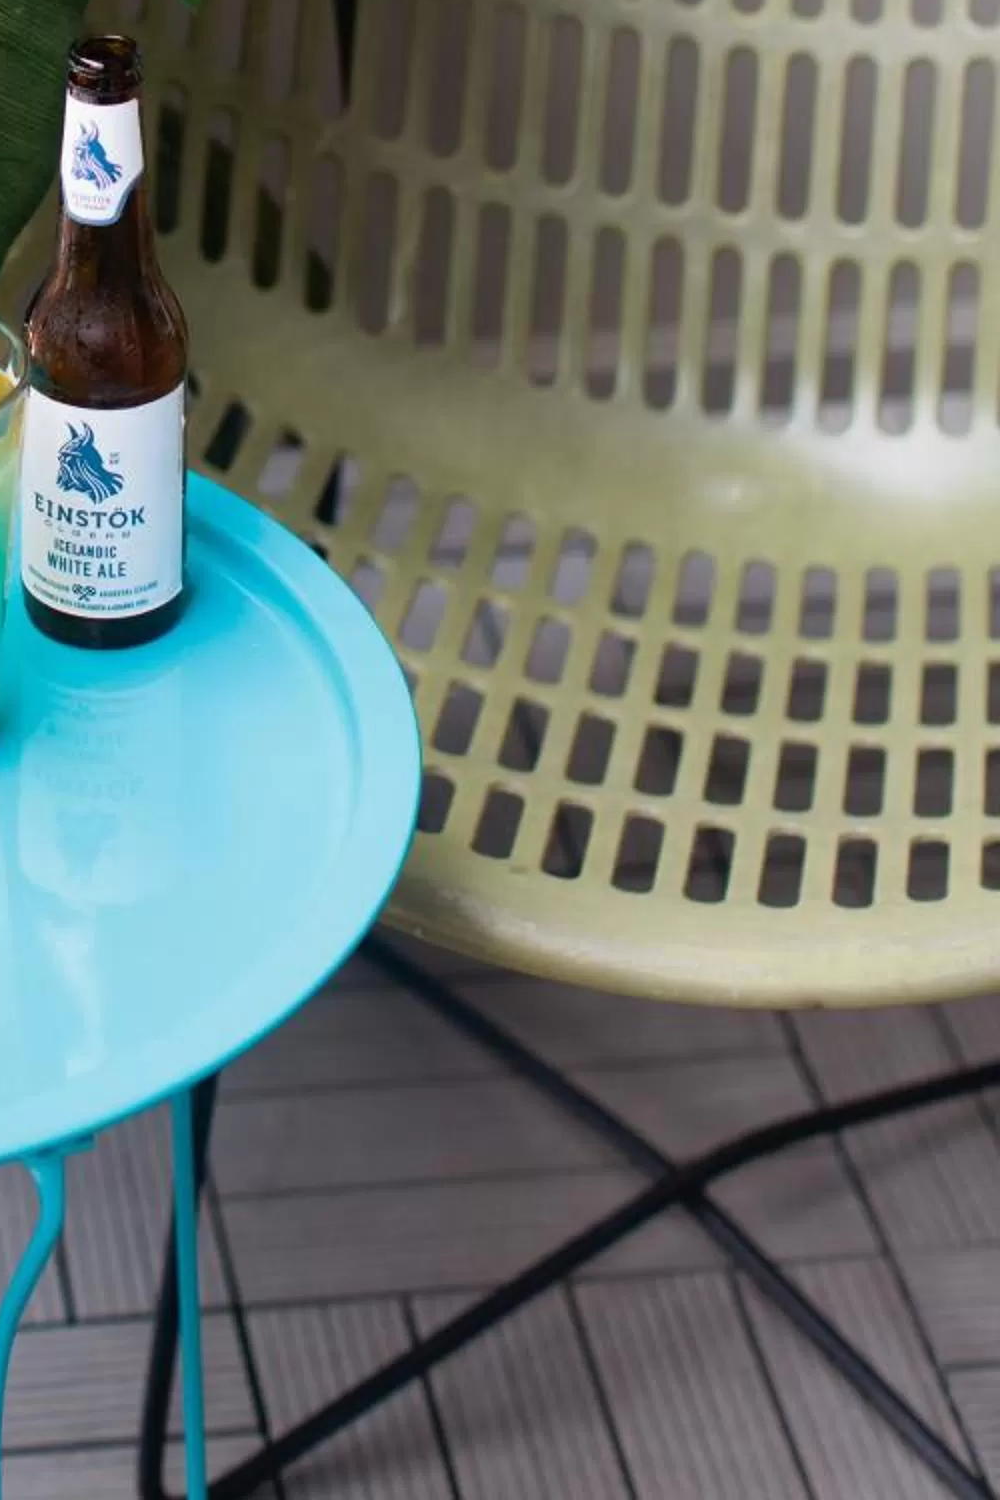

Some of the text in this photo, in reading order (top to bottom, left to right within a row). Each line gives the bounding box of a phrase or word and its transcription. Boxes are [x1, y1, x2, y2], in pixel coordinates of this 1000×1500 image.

[34, 491, 145, 529] EINSTÖK
[54, 537, 117, 559] ICELANDIC
[47, 551, 127, 579] WHITE ALE
